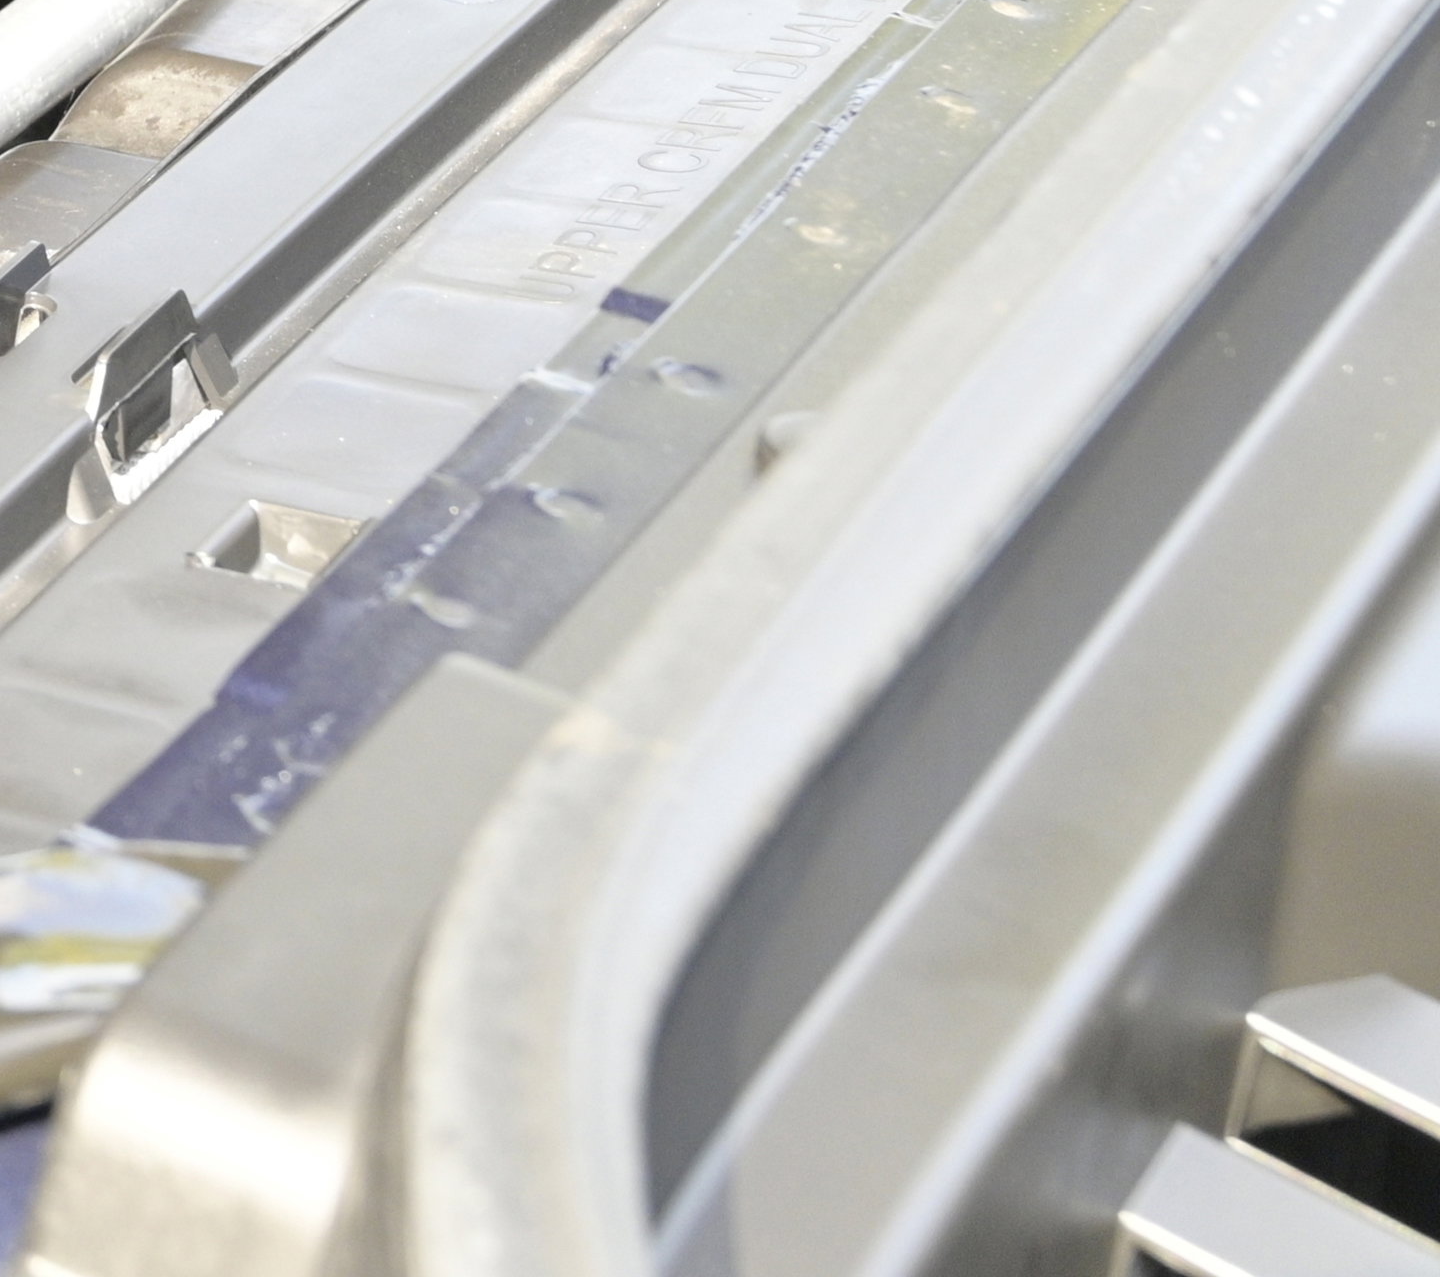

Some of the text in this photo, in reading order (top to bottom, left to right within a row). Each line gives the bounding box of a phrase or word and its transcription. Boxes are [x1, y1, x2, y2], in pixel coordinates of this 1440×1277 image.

[502, 182, 682, 306] UPPER
[636, 82, 782, 174] CRFM
[732, 11, 873, 80] DUAL
